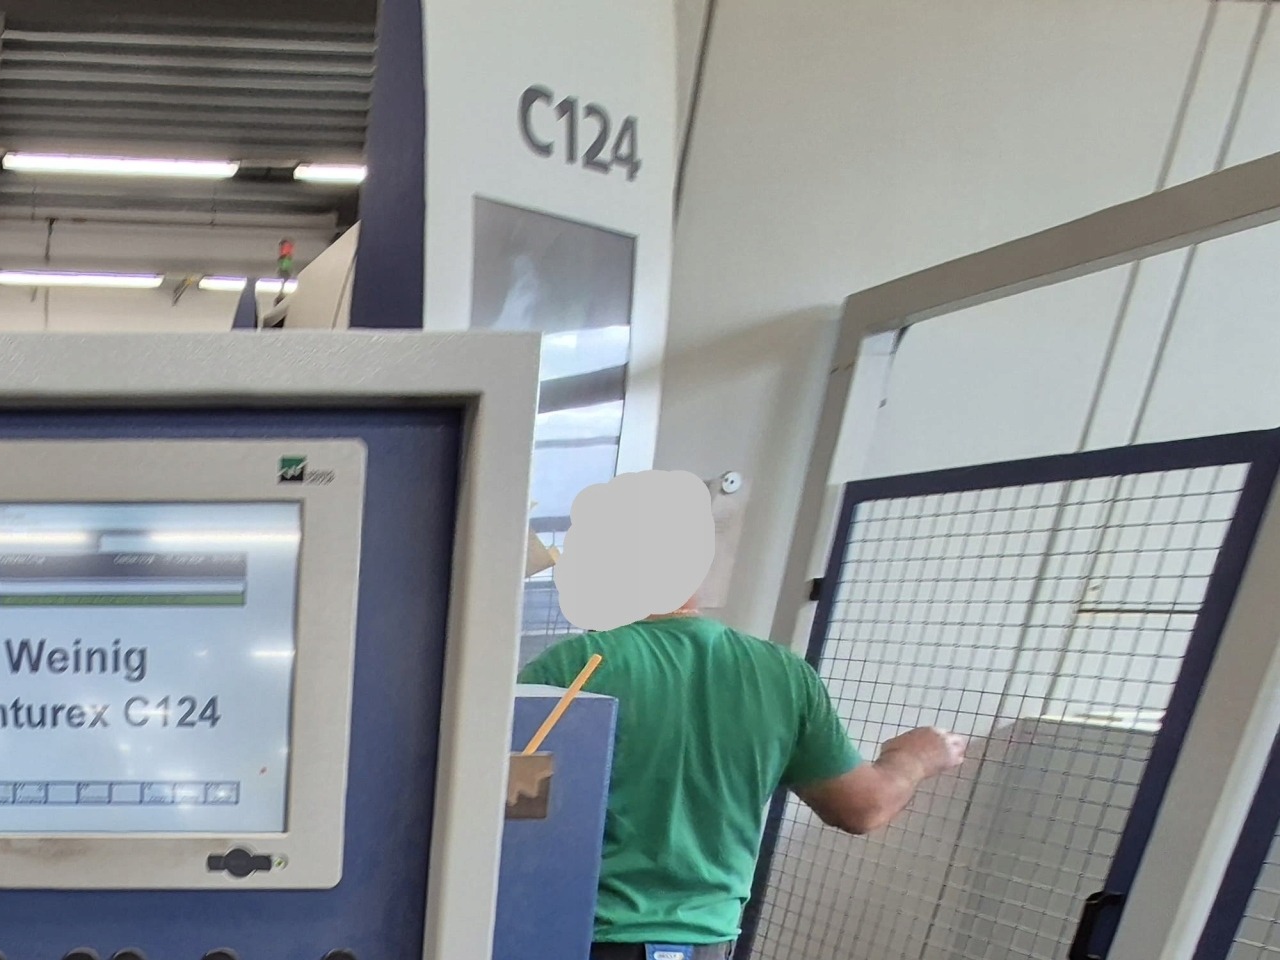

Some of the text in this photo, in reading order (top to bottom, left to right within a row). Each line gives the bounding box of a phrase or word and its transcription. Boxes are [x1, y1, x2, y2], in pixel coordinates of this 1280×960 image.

[517, 84, 642, 182] C124
[4, 638, 148, 682] Weinig
[124, 694, 221, 728] C124
